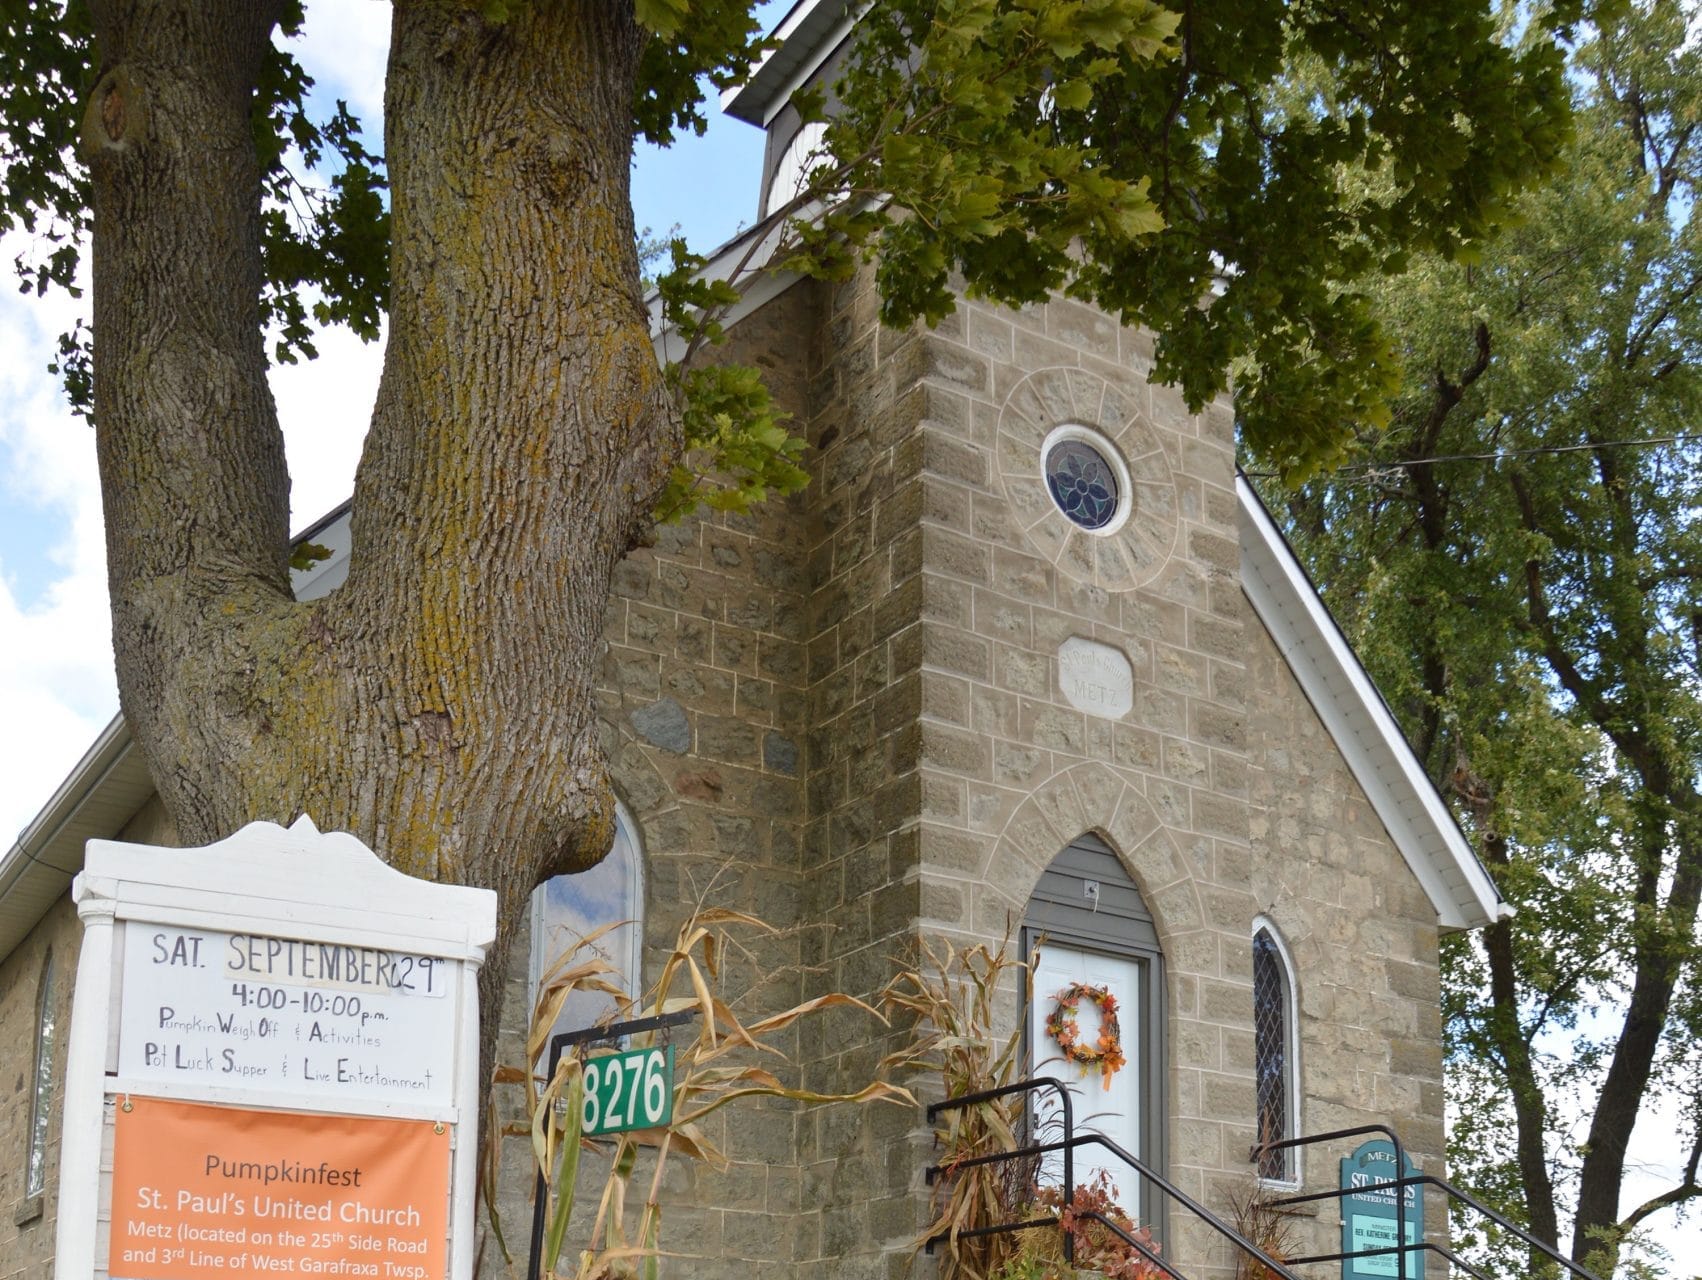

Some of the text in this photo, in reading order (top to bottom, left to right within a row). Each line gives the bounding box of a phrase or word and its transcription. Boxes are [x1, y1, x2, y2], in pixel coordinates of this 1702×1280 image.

[1074, 680, 1119, 707] METZ
[152, 933, 205, 967] SAT.
[228, 934, 391, 988] SEPTEMBER
[216, 1012, 256, 1041] Weigh
[258, 1017, 279, 1039] Off
[308, 1020, 382, 1048] Activities
[144, 1042, 167, 1068] Pot
[175, 1044, 214, 1072] Luck
[221, 1048, 268, 1079] Supper
[303, 1057, 331, 1082] Live
[336, 1058, 433, 1090] Entertainment
[581, 1049, 666, 1133] 8276
[205, 1154, 362, 1188] Pumpkinfest
[137, 1187, 421, 1227] St. Paul's United Church
[1352, 1194, 1416, 1208] UNITED CHCH
[127, 1220, 428, 1255] Metz (located on the 25th Side Road
[122, 1247, 430, 1280] and 3rd Line of West Garafraxa Twsp.
